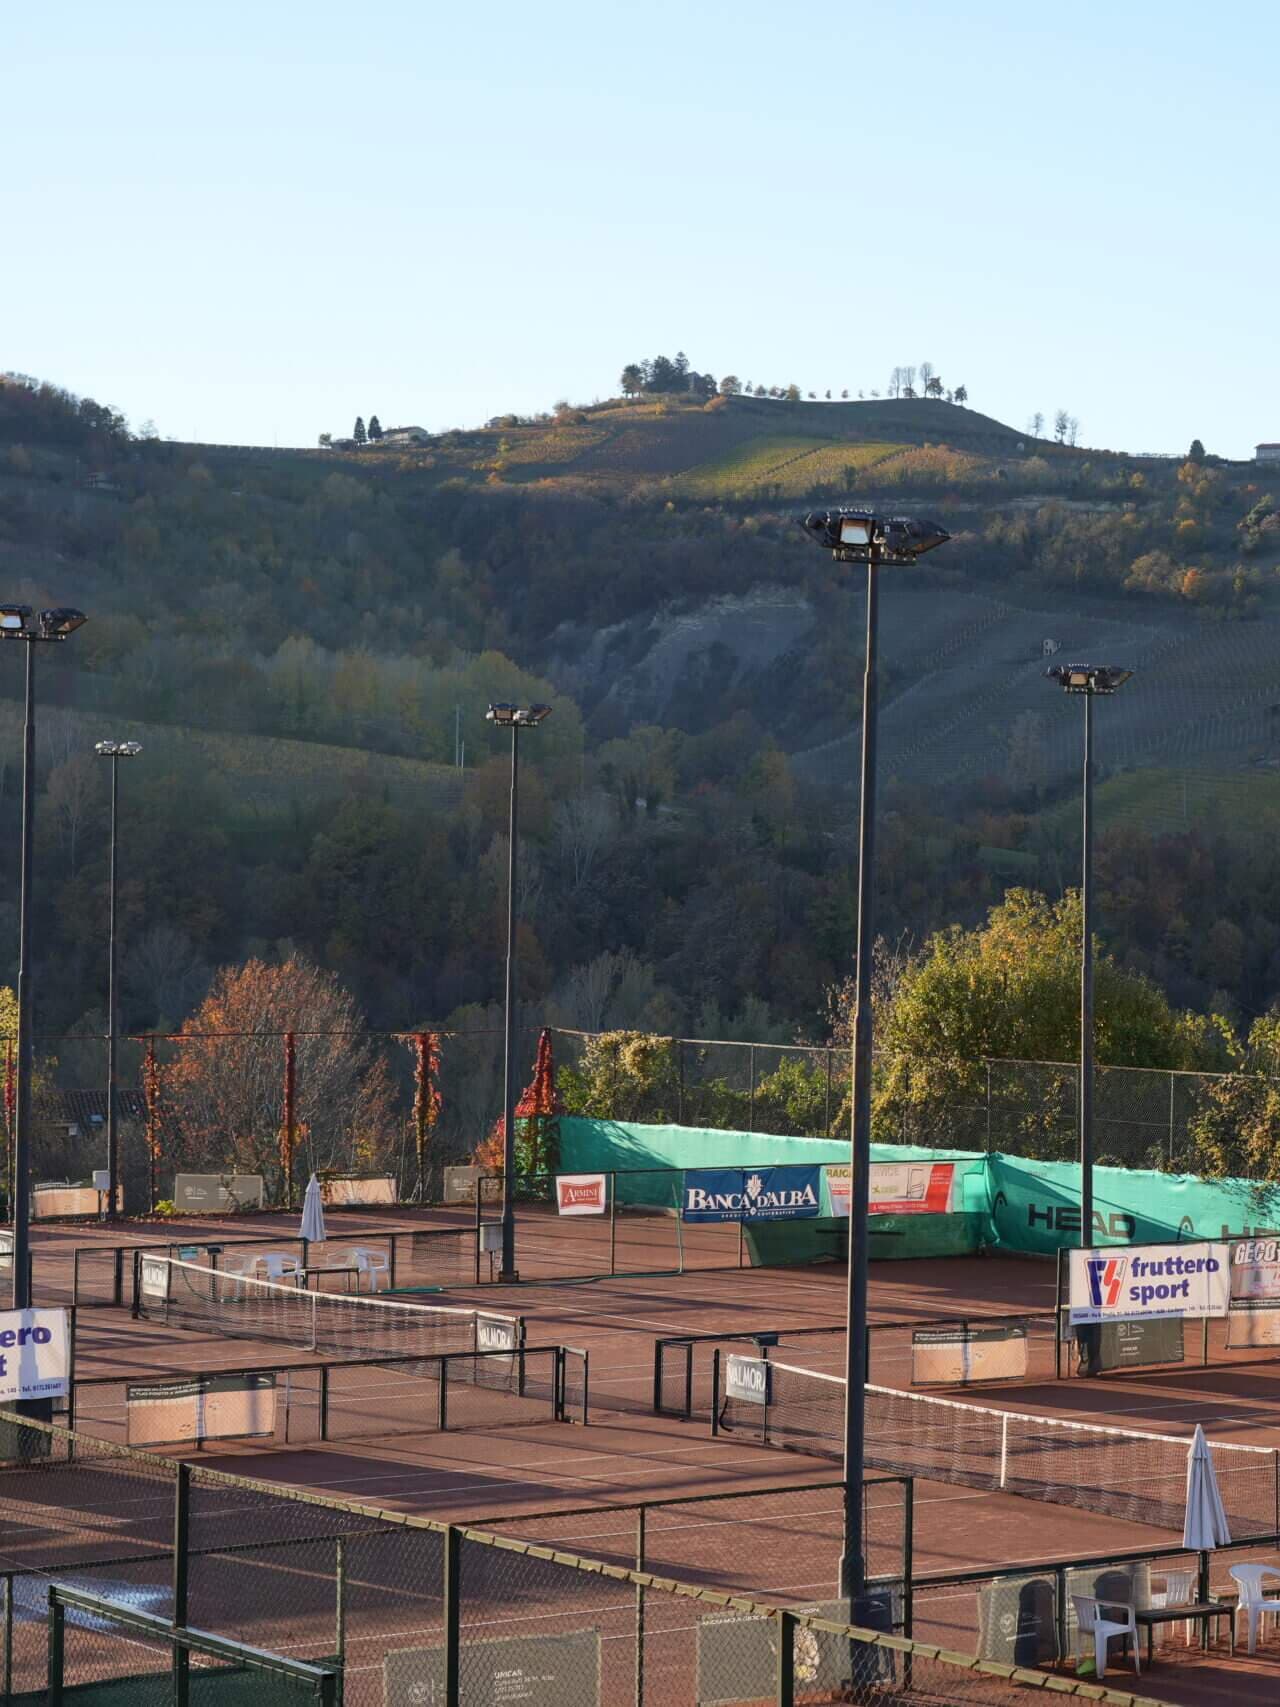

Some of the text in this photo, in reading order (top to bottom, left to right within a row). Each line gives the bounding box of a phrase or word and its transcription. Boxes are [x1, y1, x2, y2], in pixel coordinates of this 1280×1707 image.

[686, 1188, 751, 1210] BANCA
[1027, 1203, 1137, 1240] HEAD
[1234, 1239, 1278, 1265] GECO
[1130, 1256, 1220, 1278] fruttero
[1129, 1278, 1190, 1307] sport
